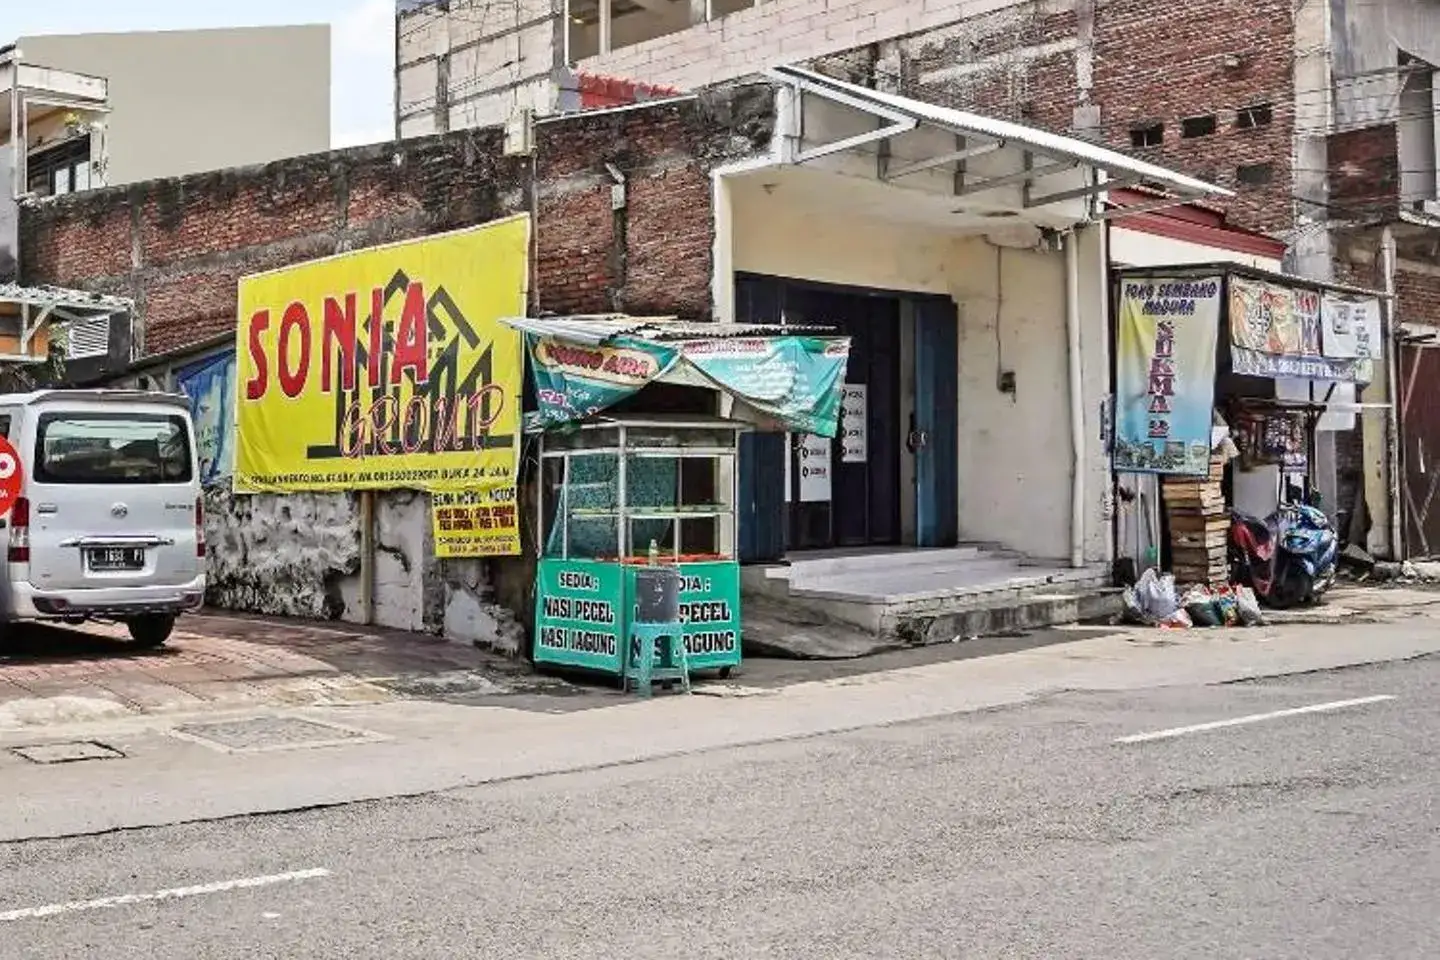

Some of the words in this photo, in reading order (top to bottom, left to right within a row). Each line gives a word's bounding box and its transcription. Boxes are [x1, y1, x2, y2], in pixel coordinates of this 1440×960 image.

[247, 282, 429, 401] SONIA
[543, 596, 571, 618] NASI
[574, 600, 614, 623] PECEL
[540, 626, 567, 648] NASI
[571, 628, 616, 655] JAGUNG
